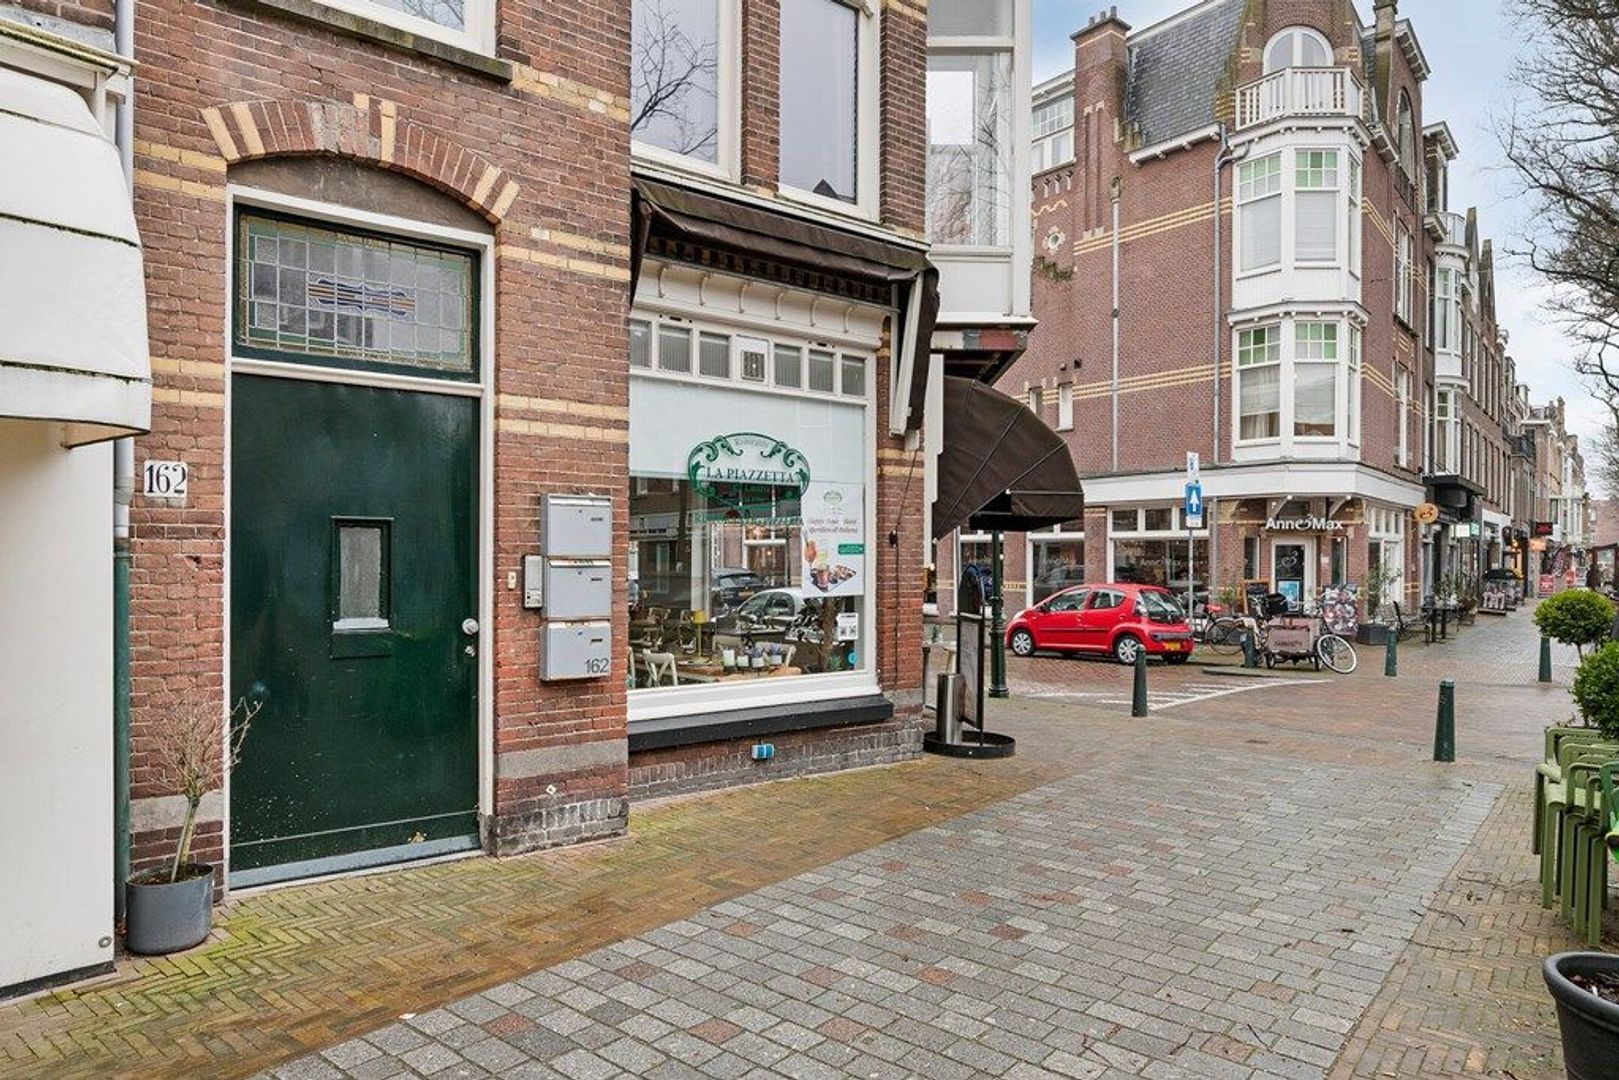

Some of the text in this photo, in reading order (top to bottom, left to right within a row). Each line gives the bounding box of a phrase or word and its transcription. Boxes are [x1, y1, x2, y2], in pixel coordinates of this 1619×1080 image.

[145, 463, 186, 494] 162
[706, 467, 794, 483] LA PIAZZETTA
[584, 657, 609, 674] 162
